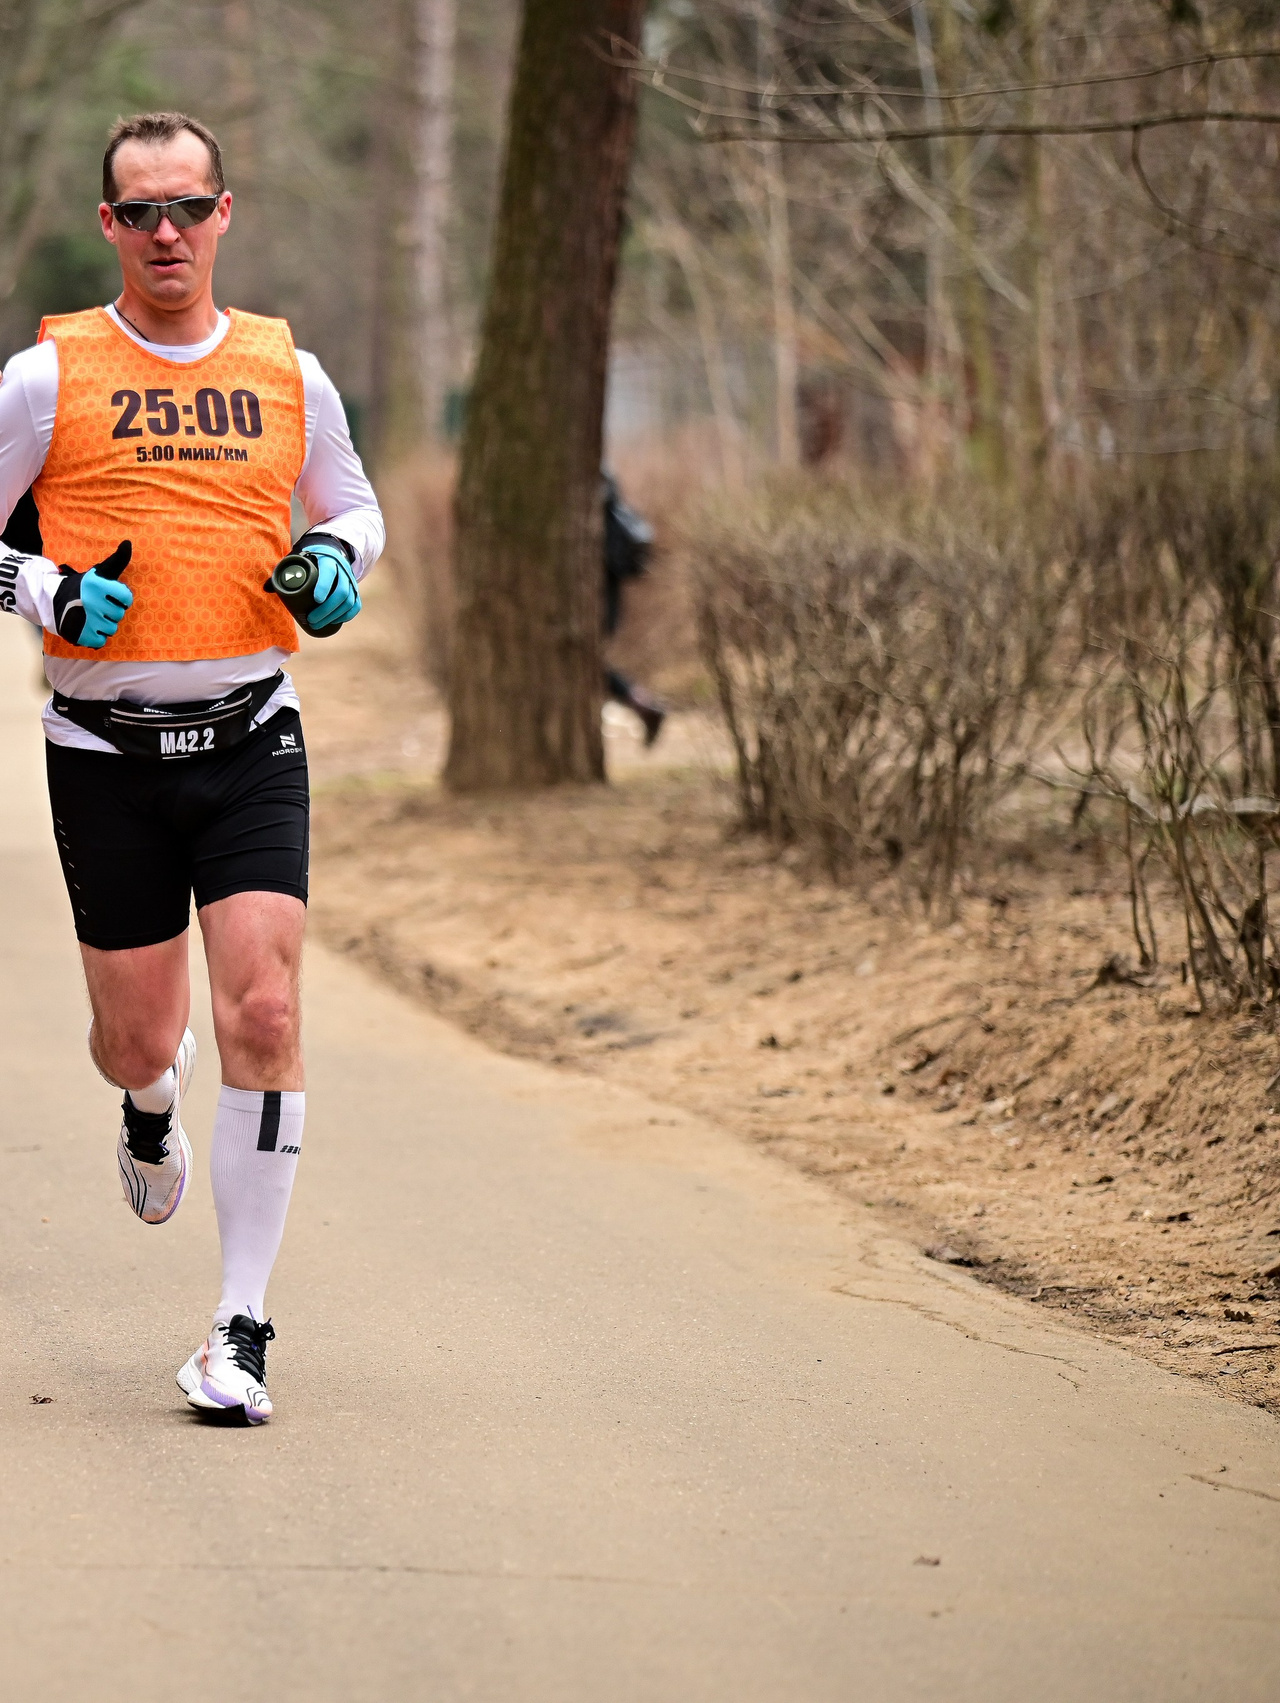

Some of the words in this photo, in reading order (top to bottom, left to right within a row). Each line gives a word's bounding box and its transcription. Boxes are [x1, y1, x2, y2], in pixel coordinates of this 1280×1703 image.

[111, 387, 263, 440] 25:00
[136, 445, 174, 463] 5:00
[160, 727, 215, 754] M42.2
